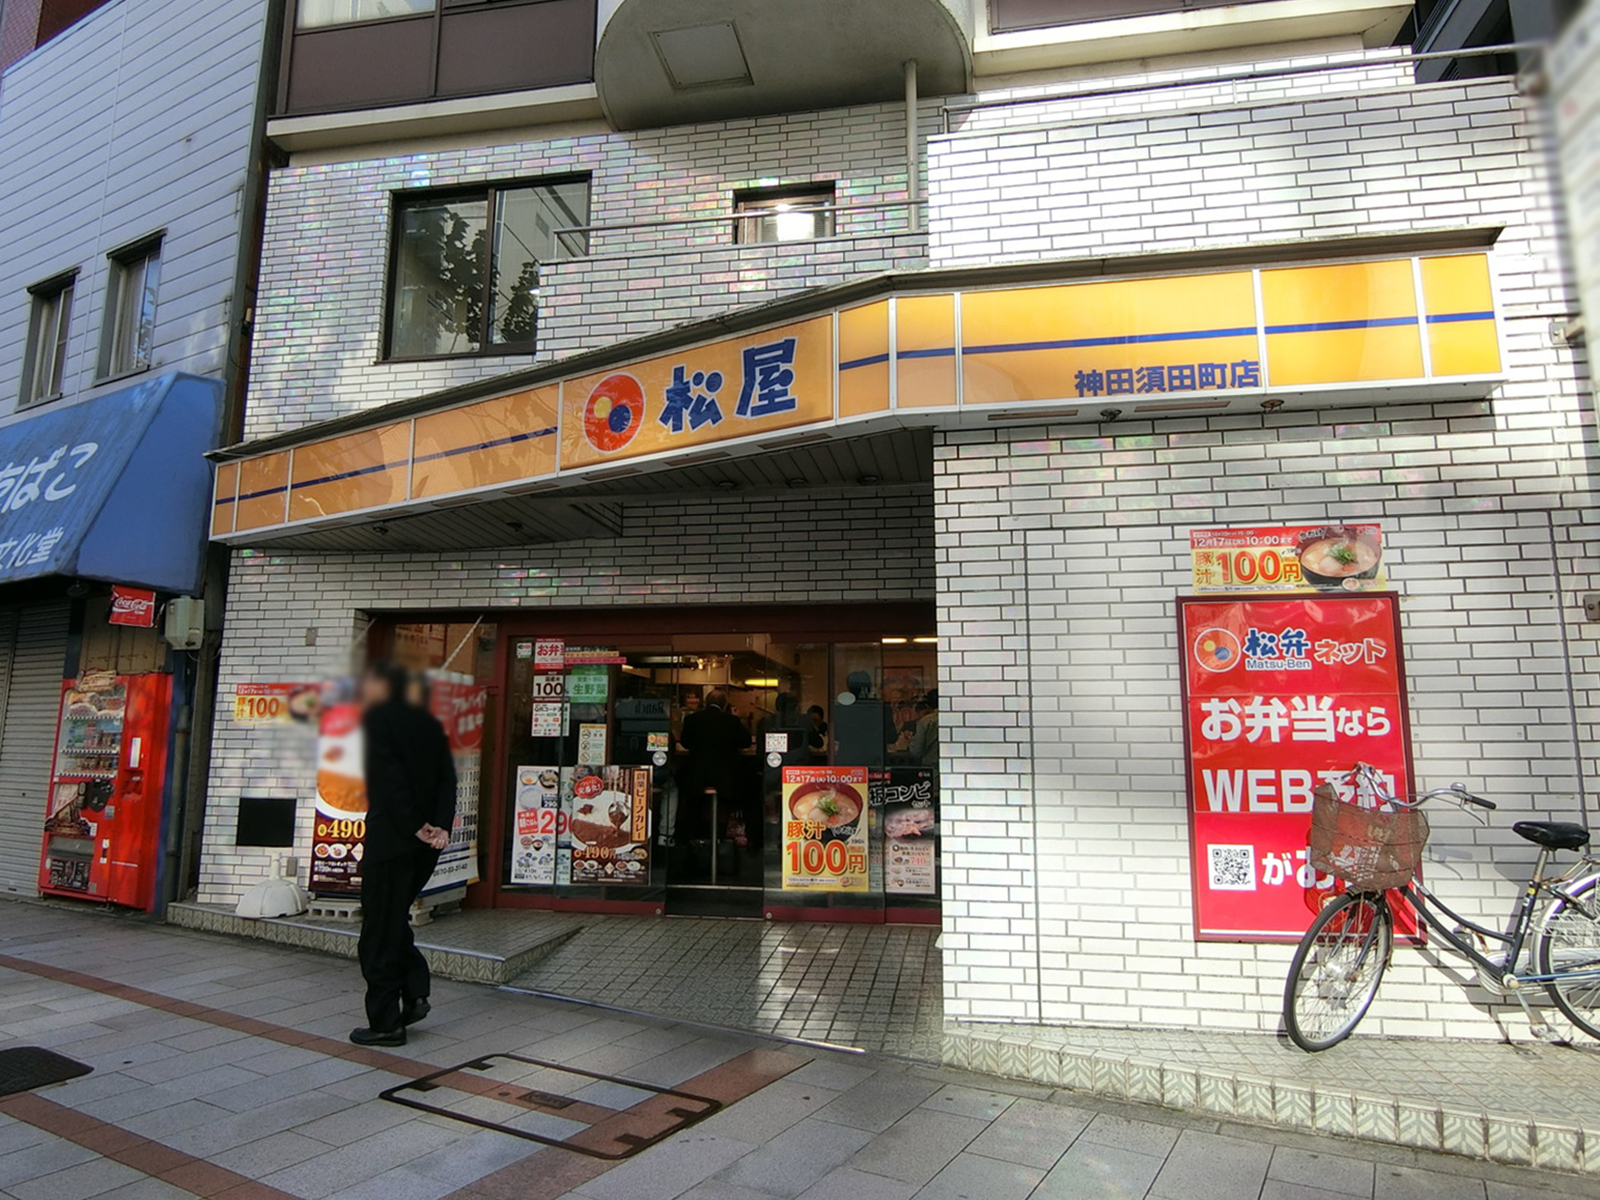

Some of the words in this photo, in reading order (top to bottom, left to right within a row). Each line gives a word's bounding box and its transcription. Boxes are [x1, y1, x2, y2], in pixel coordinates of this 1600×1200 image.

[658, 336, 798, 434] 松屋
[1074, 360, 1260, 397] 神田須田町店
[1215, 550, 1300, 583] 100円
[1244, 627, 1311, 658] 松弁
[1314, 638, 1387, 665] ネット
[1246, 658, 1311, 670] Matsu-Ben
[1201, 695, 1391, 742] お弁当なら
[328, 819, 366, 838] 490
[787, 821, 825, 838] 豚汁
[787, 840, 864, 873] 100円
